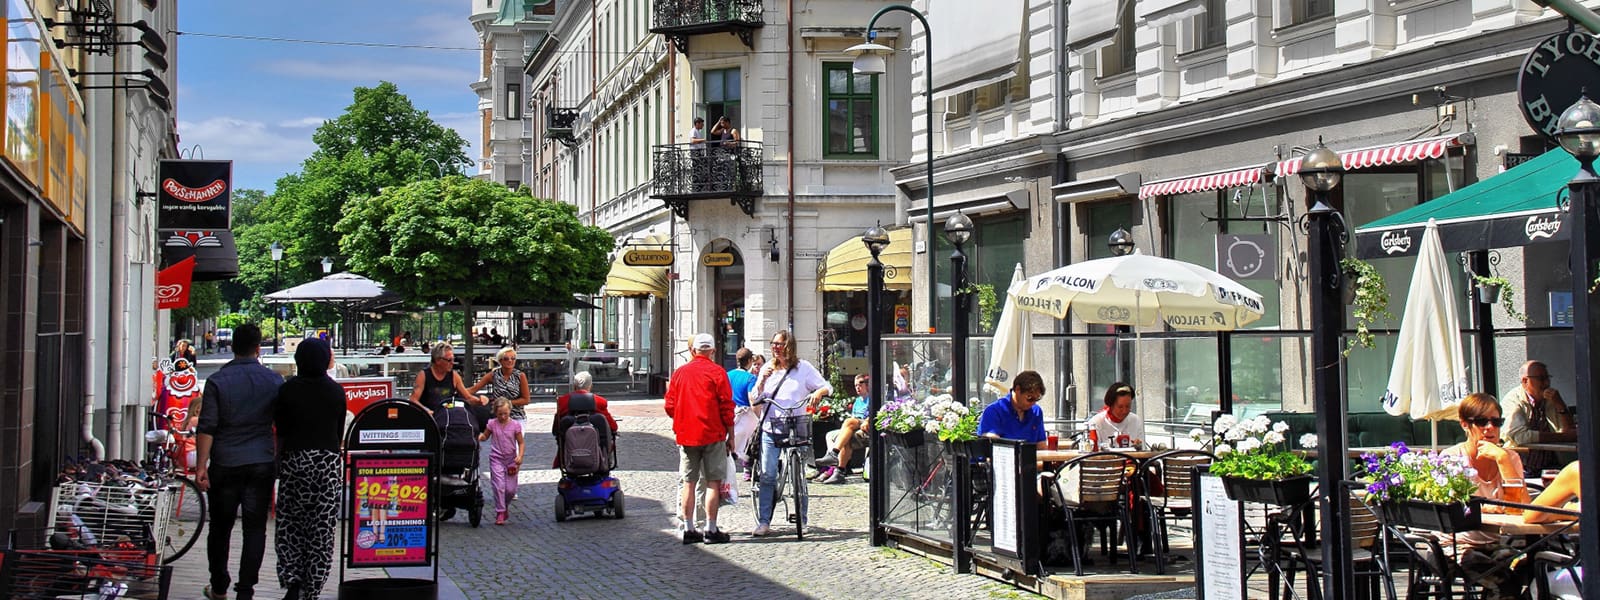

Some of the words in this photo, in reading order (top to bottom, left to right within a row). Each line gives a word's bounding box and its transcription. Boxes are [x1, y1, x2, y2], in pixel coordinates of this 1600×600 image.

[1526, 214, 1561, 236] Carlsberg
[1381, 230, 1411, 249] Carlsberg
[356, 482, 427, 500] 30-50%
